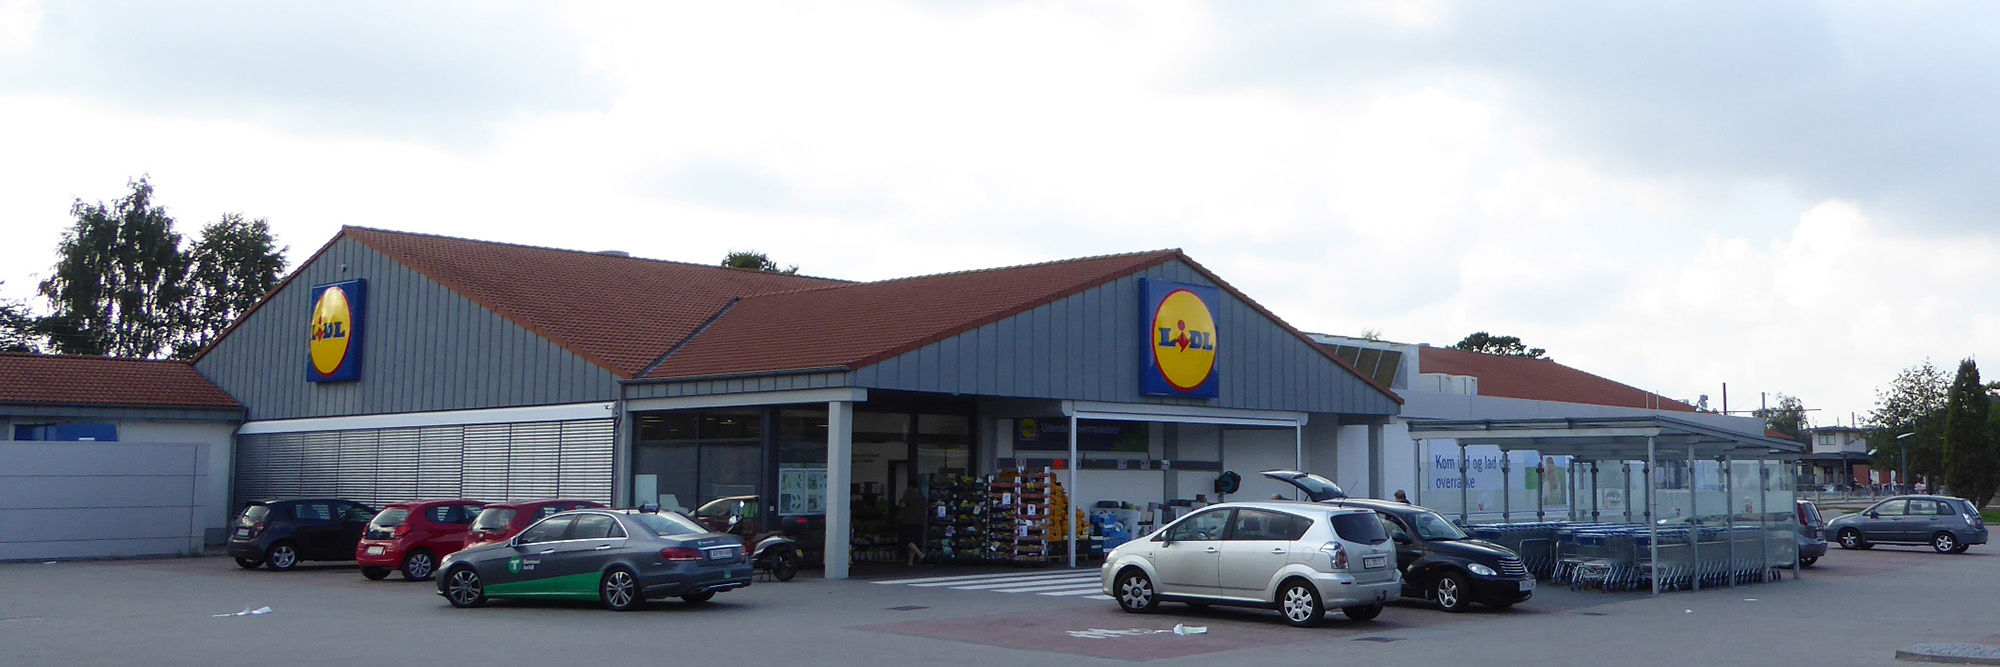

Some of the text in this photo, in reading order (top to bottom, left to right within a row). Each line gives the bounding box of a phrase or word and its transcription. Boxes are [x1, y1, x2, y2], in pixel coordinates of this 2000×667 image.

[1435, 455, 1455, 469] Kom
[1457, 455, 1470, 470] id
[1473, 459, 1483, 472] og
[1485, 455, 1497, 470] lad
[1435, 476, 1475, 489] overrake
